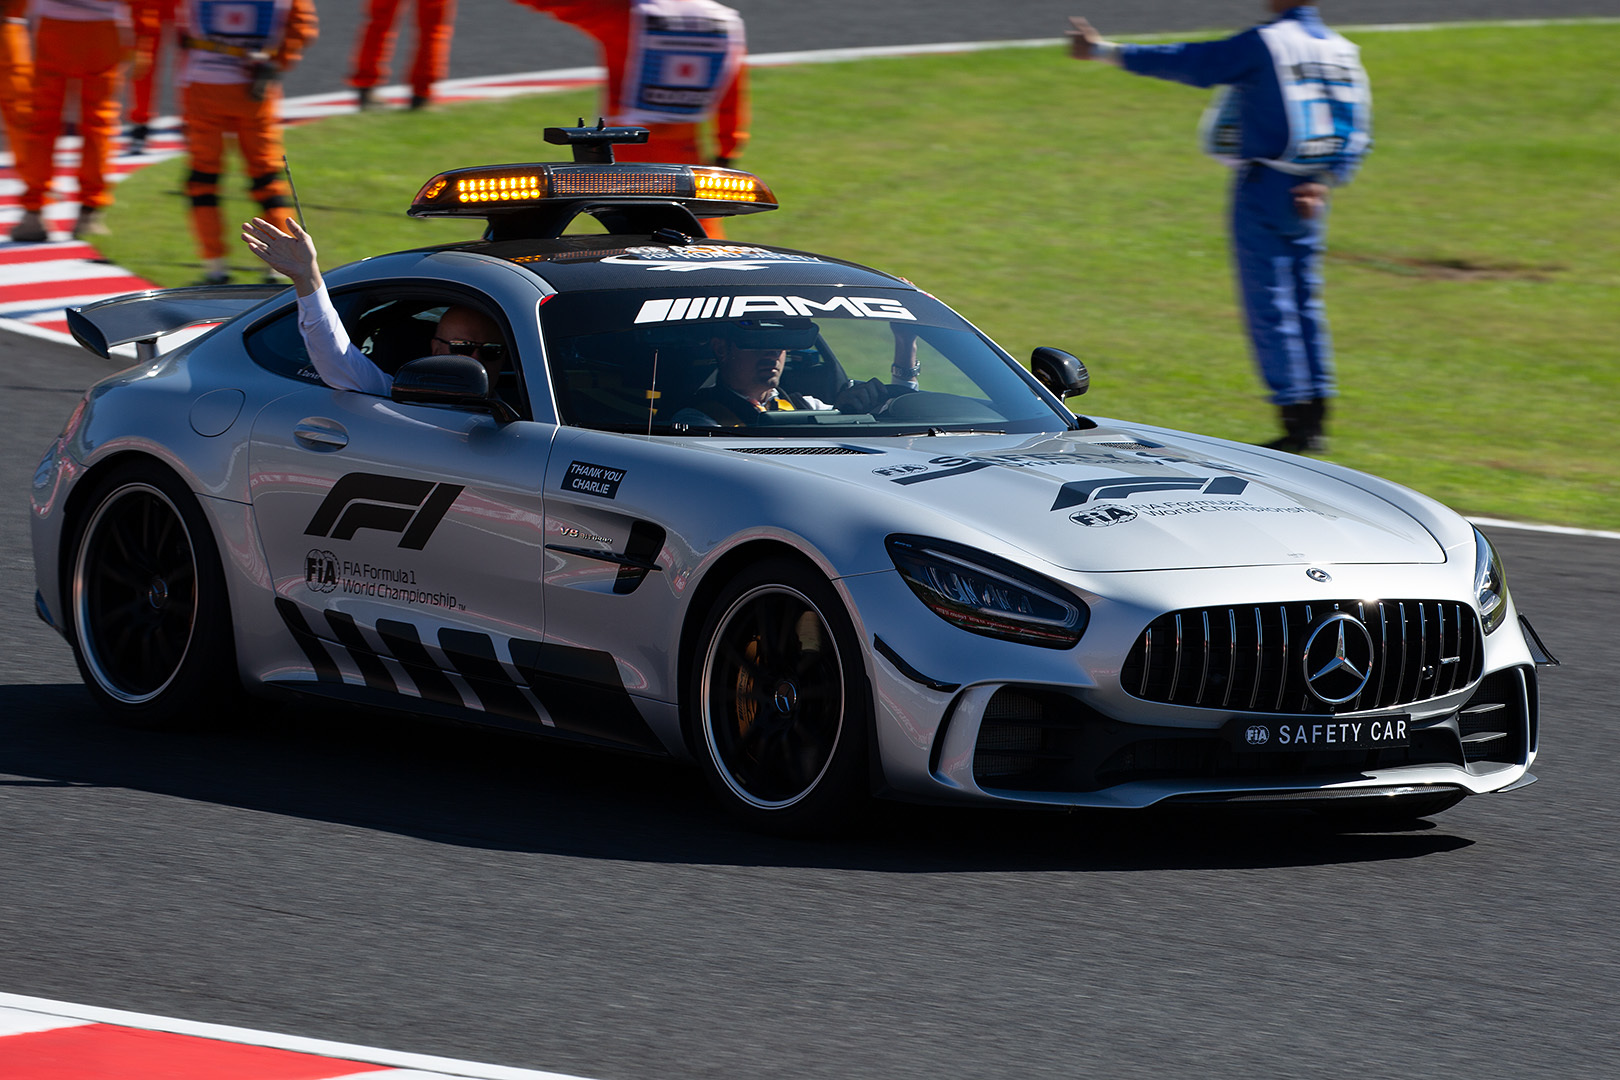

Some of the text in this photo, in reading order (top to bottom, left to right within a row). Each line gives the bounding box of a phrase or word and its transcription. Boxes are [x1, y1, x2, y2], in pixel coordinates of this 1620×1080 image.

[729, 296, 917, 321] AMG
[570, 463, 623, 482] THANK YOU
[572, 478, 610, 494] CHARLIE
[1143, 507, 1201, 517] World
[560, 526, 579, 538] V8
[343, 561, 362, 577] FIA
[363, 564, 409, 583] Formula
[343, 578, 376, 597] World
[377, 583, 457, 610] Championship
[1278, 722, 1362, 745] SAFETY
[1370, 720, 1407, 741] CAR
